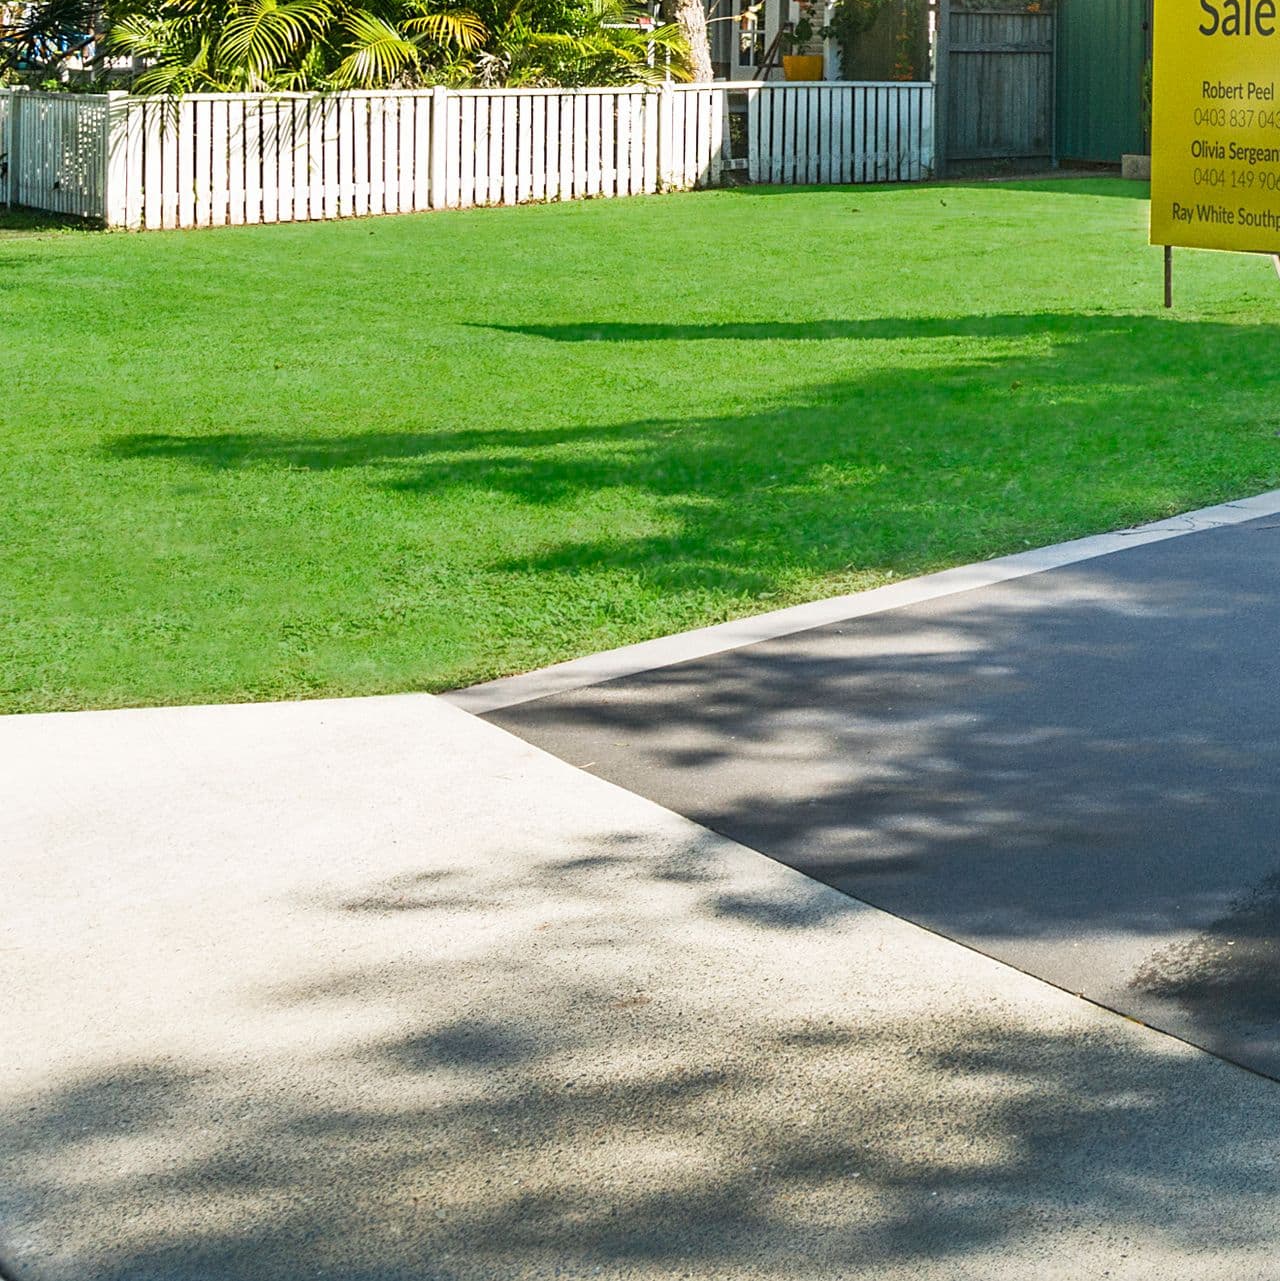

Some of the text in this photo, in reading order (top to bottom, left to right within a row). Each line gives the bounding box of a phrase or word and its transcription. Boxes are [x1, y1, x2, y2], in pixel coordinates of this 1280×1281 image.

[1202, 81, 1274, 101] Robert Peel
[1194, 107, 1226, 128] 0403
[1229, 108, 1255, 129] 837
[1191, 140, 1225, 160] Olivia
[1193, 167, 1225, 187] 0404
[1231, 169, 1255, 189] 149
[1172, 201, 1194, 224] Ray
[1196, 204, 1235, 225] White
